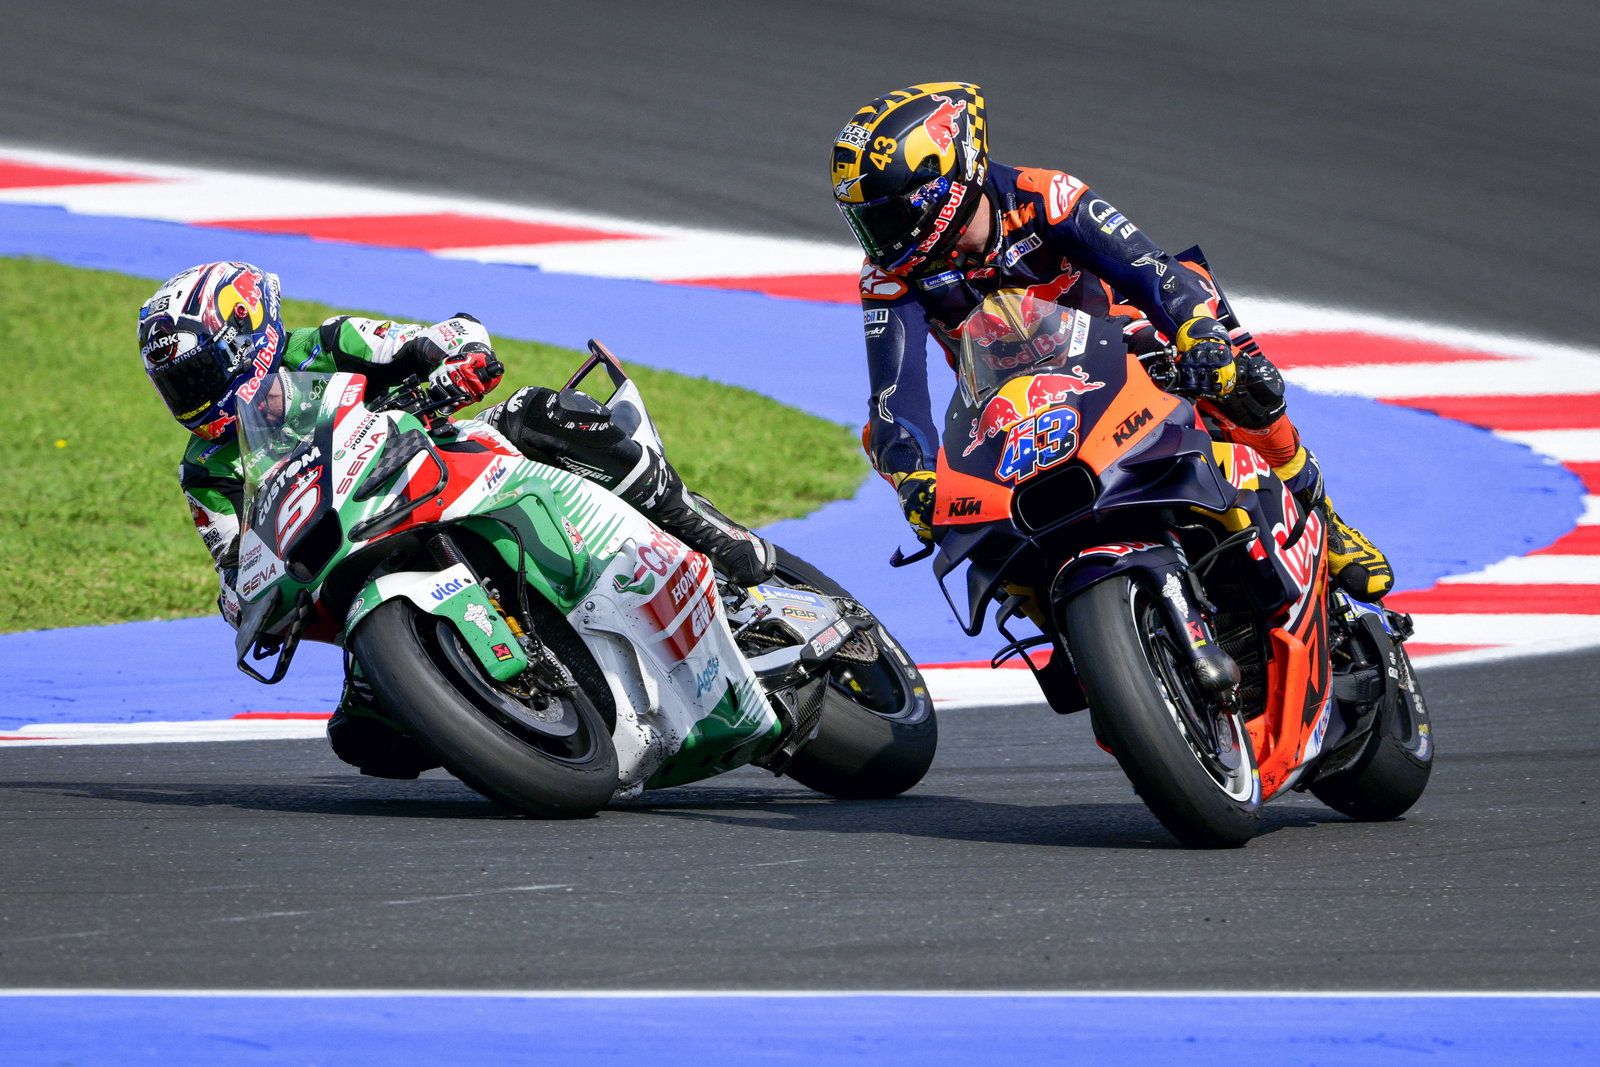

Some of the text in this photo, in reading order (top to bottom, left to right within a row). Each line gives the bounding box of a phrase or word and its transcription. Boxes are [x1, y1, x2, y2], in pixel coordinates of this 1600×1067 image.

[869, 136, 898, 171] 43
[916, 218, 950, 253] Red
[939, 181, 967, 223] Bull
[1006, 240, 1032, 266] Mobil
[172, 345, 203, 365] WINGS
[235, 323, 279, 404] Red Bull
[982, 331, 1072, 370] Red Bu
[344, 413, 373, 448] Castrol
[995, 404, 1080, 484] 43
[1112, 407, 1154, 447] KTM
[336, 431, 386, 495] SENA
[258, 446, 322, 527] CUSTOM
[275, 464, 324, 561] 5
[948, 496, 983, 518] KTM
[242, 563, 277, 597] SENA
[430, 578, 464, 601] viar
[671, 554, 709, 606] HONDA
[774, 590, 817, 603] MICHELIN
